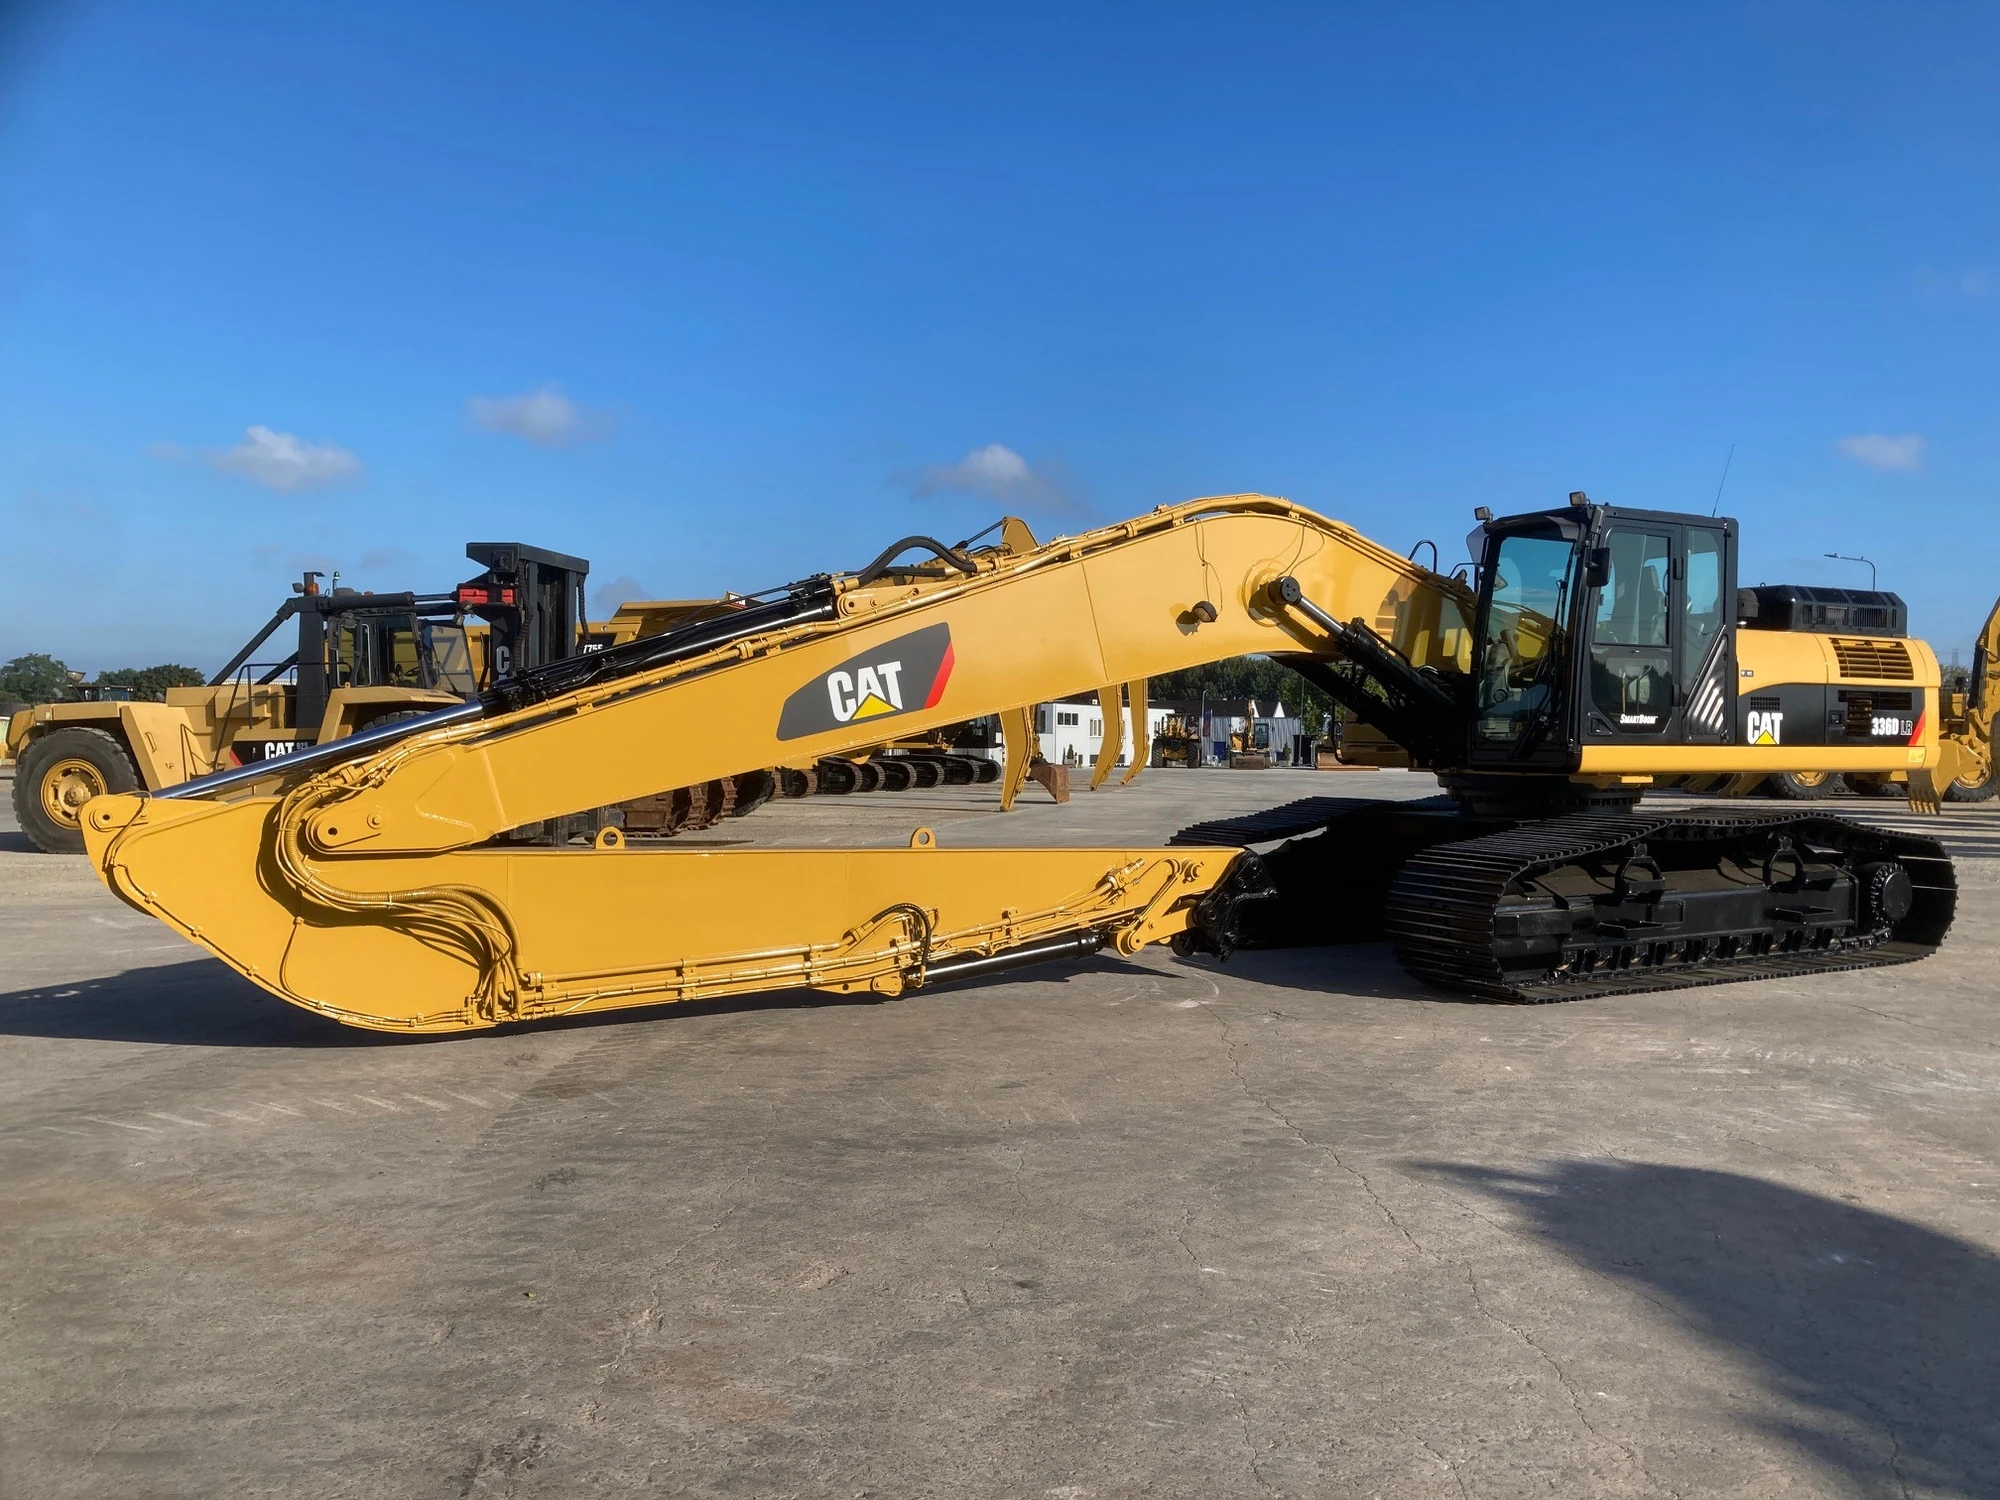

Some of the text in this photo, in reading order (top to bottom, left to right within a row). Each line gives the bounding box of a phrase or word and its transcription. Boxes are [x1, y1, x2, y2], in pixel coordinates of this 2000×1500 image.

[827, 661, 903, 722] CAT
[1747, 711, 1784, 744] CAT
[1871, 717, 1913, 735] 336D LR
[265, 742, 295, 760] CAT
